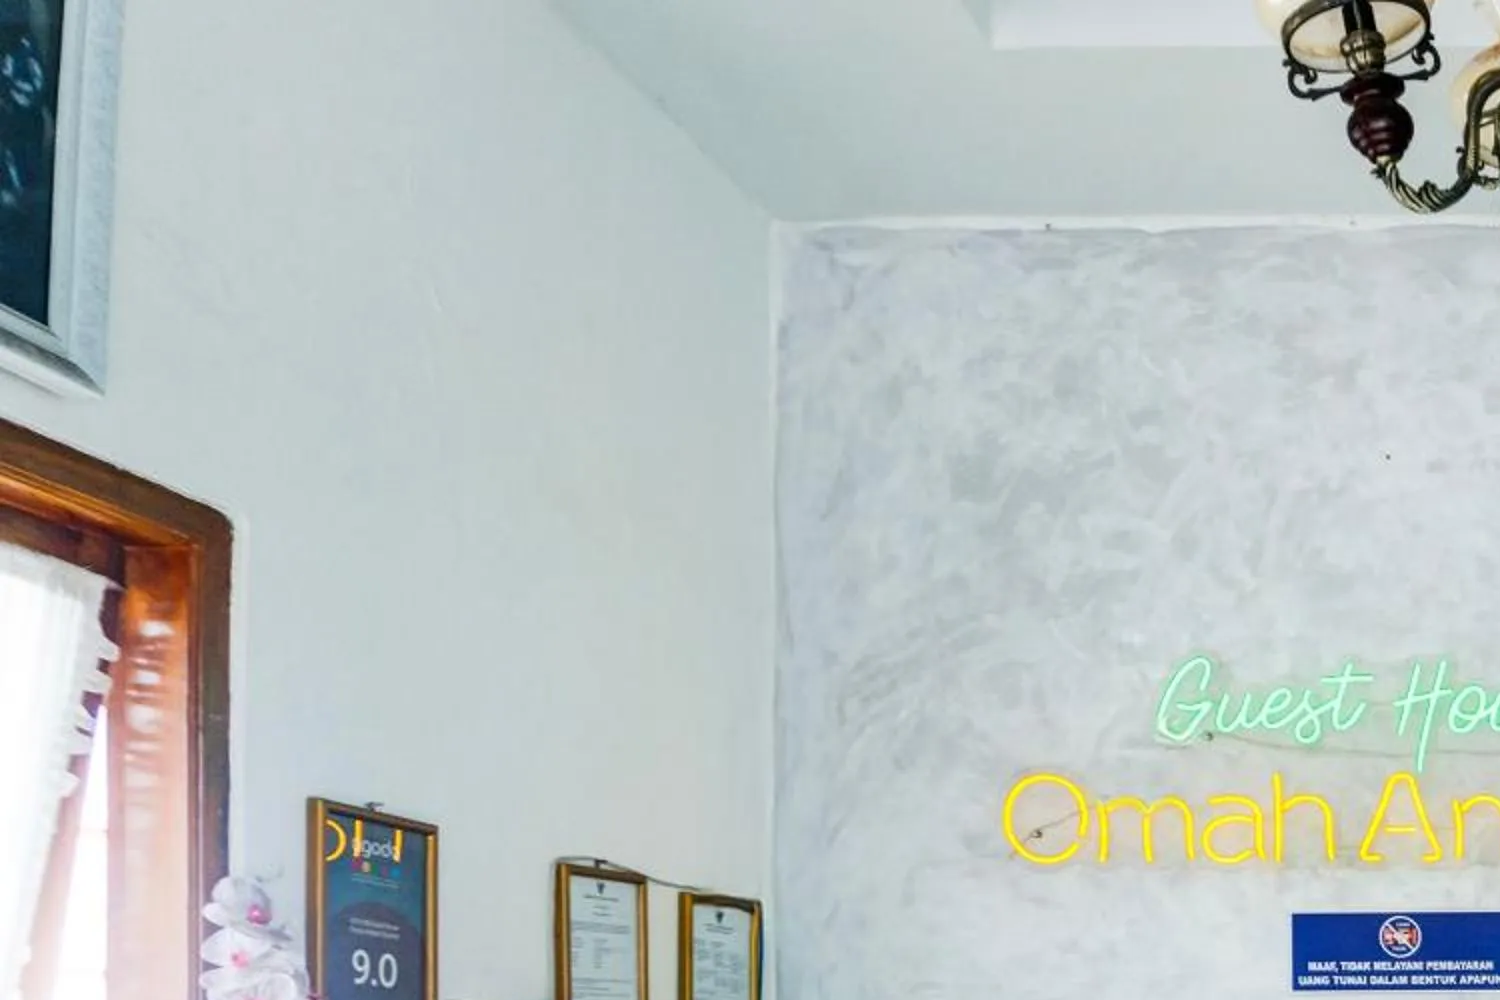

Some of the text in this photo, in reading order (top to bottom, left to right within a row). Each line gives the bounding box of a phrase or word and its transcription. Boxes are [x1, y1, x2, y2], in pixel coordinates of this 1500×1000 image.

[1155, 656, 1373, 744] Guest
[1002, 772, 1337, 864] Omah
[351, 948, 398, 989] 9.0
[1298, 975, 1331, 986] UANG
[1333, 975, 1367, 985] TUNAI
[1370, 975, 1408, 985] DALAM
[1411, 975, 1458, 985] BENTUK
[1308, 960, 1494, 973] MAAF, TIDAK MELAYANI PEMBAYARAN
